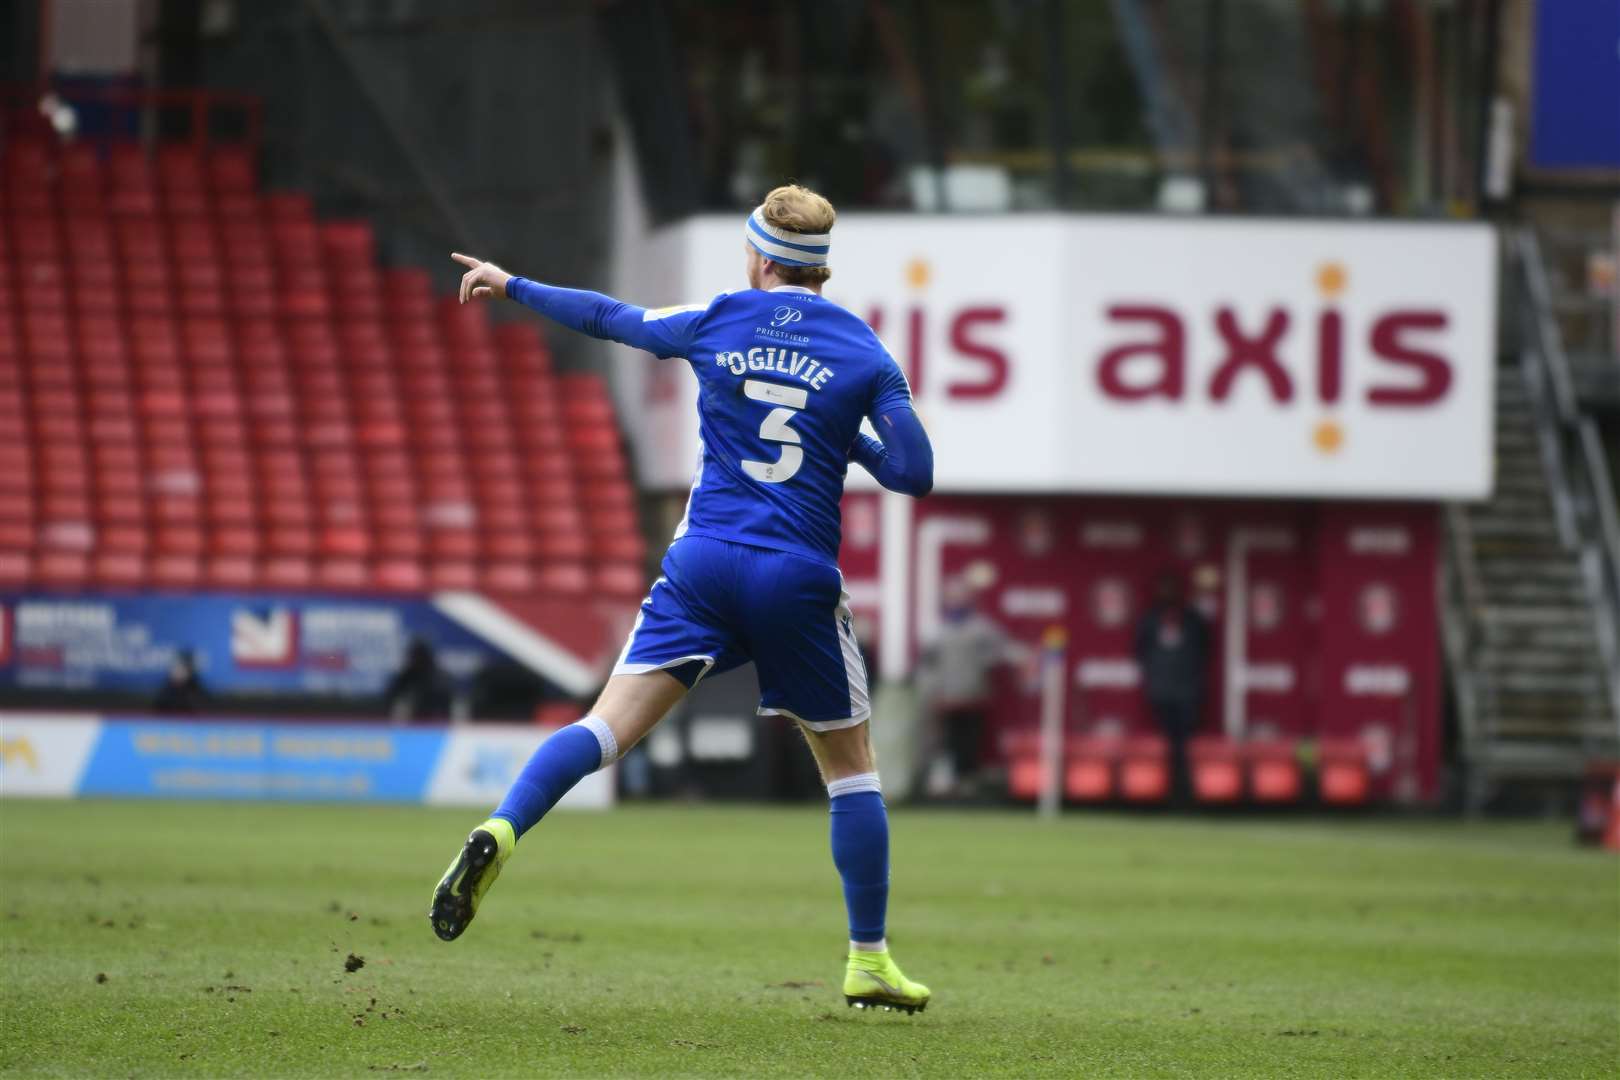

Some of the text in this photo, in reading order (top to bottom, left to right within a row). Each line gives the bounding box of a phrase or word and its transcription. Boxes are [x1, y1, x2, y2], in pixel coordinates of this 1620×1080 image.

[756, 327, 810, 343] PRIESTFIELD
[1094, 263, 1454, 406] axis
[741, 379, 808, 483] 3
